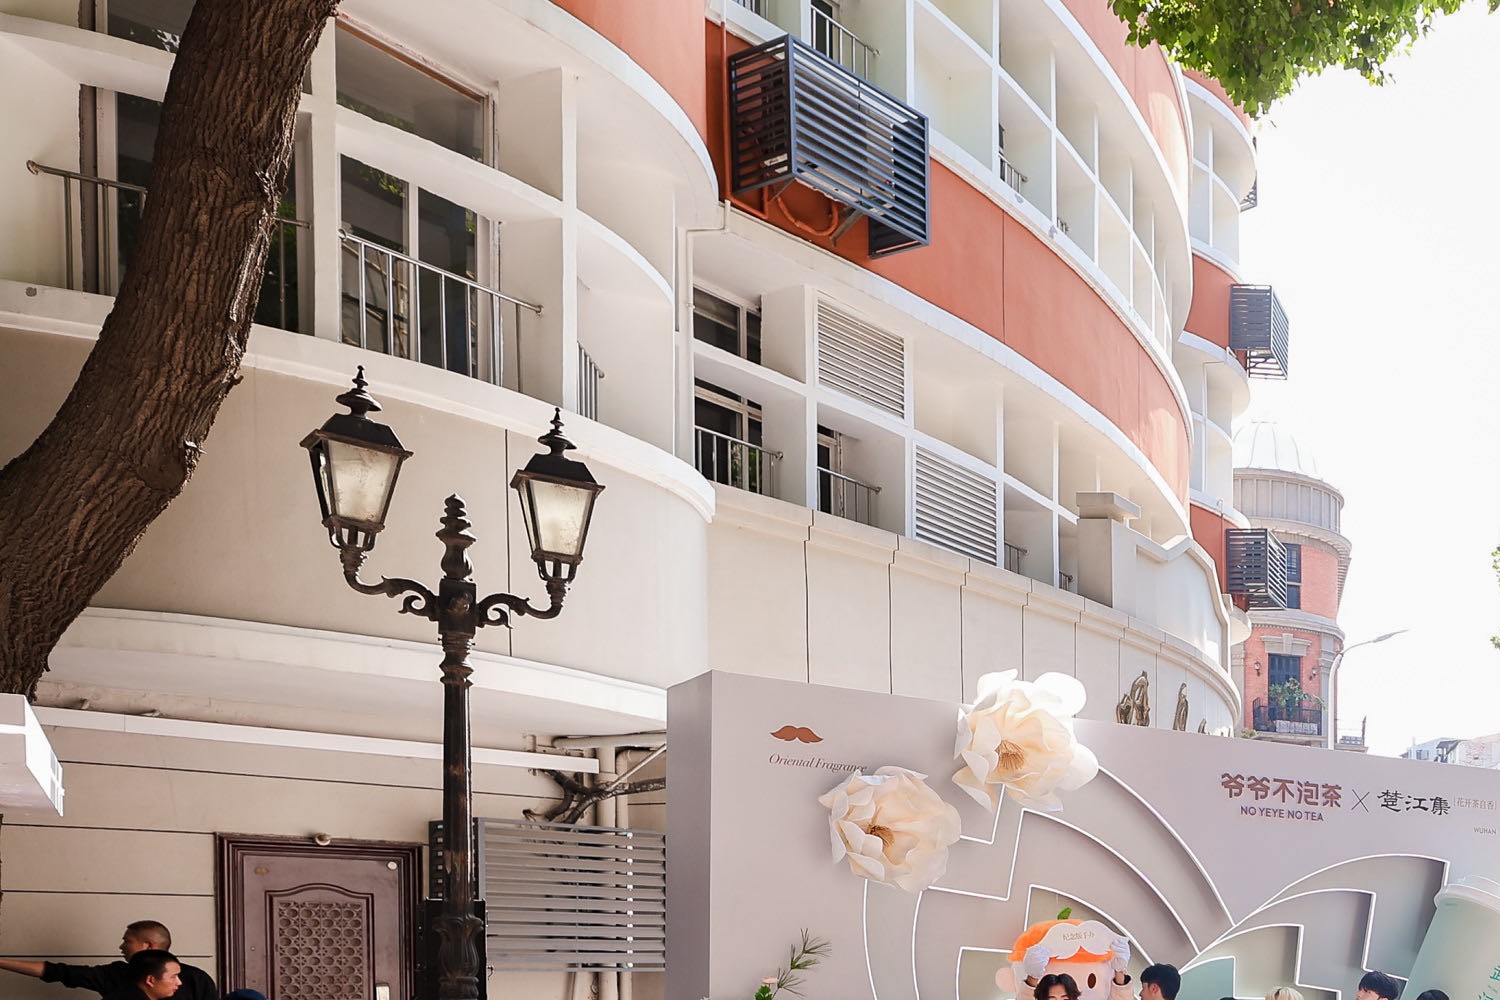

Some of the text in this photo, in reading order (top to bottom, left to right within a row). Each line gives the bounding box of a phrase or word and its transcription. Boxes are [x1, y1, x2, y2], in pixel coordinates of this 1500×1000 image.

[769, 753, 815, 768] Oriental
[1221, 772, 1342, 808] 爷爷不泡茶
[1240, 805, 1324, 822] NO YEYE NO TEA
[1473, 826, 1497, 835] WUHAN
